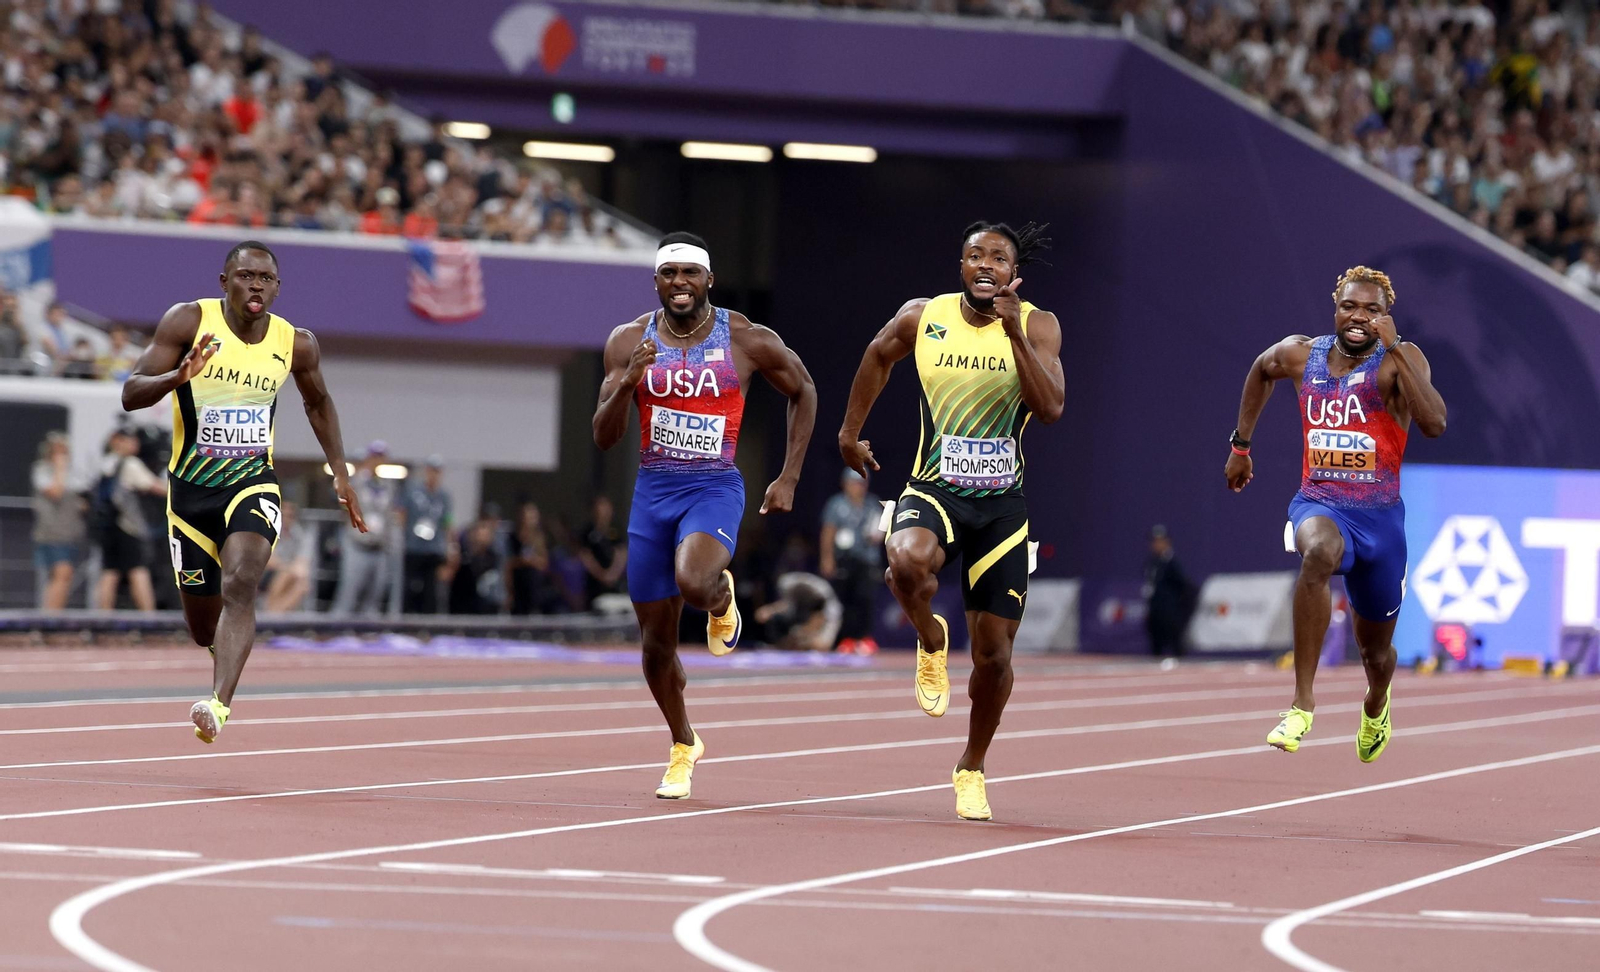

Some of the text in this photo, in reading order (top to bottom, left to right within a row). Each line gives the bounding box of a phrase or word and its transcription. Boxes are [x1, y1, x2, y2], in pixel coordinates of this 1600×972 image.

[935, 353, 1007, 372] JAMAICA
[203, 364, 277, 393] JAMAICA
[647, 368, 720, 398] USA
[220, 409, 265, 424] TDK
[1307, 394, 1367, 428] USA
[671, 412, 719, 433] TDK
[201, 427, 267, 444] SEVILLE
[653, 426, 720, 452] BEDNAREK
[1321, 432, 1370, 450] TDK
[962, 440, 1011, 455] TDK
[944, 456, 1013, 474] THOMPSON
